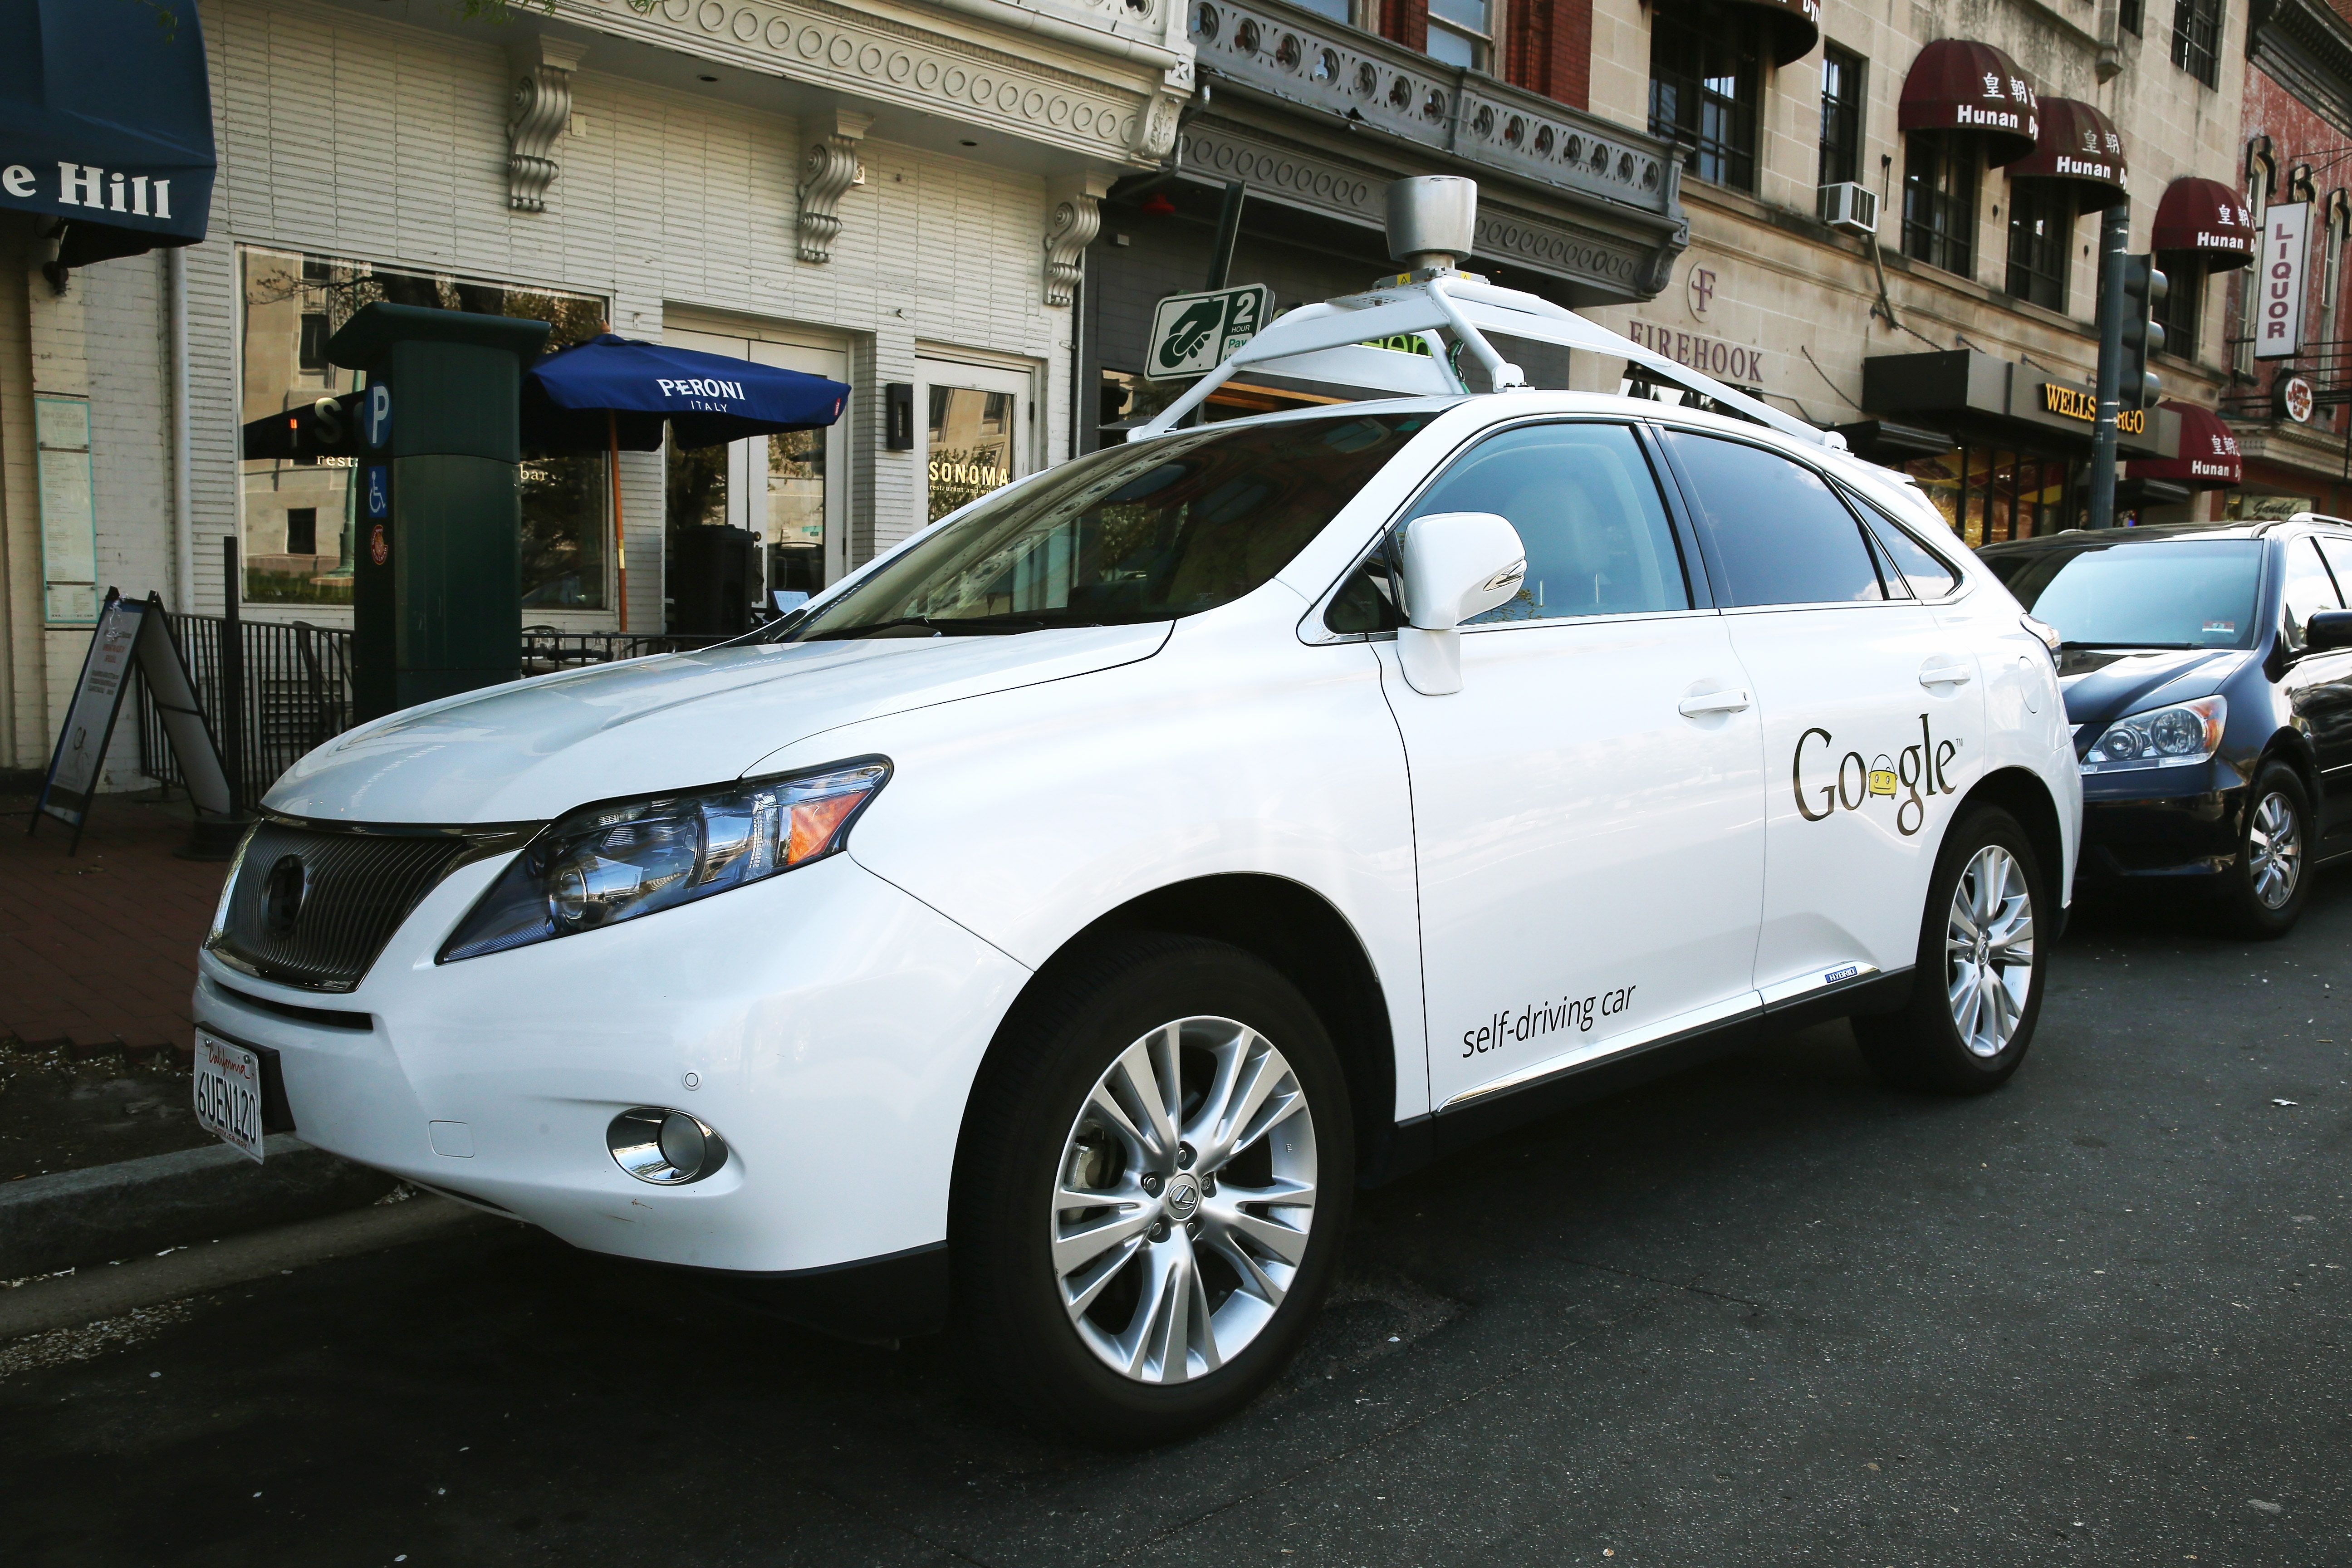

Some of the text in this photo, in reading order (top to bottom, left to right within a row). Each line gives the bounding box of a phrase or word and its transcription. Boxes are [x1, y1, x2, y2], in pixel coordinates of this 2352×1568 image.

[1957, 105, 2018, 128] Hunan
[2057, 156, 2111, 178] Hunan
[58, 162, 171, 219] Hill
[2218, 204, 2255, 230] 皇朝
[2197, 232, 2243, 249] Hunan
[2268, 223, 2293, 338] LIQUOR
[1233, 293, 1255, 324] 2
[1231, 325, 1250, 333] HOUR
[1629, 320, 1764, 382] FIREHOOK
[656, 378, 746, 400] PERONI
[372, 386, 390, 444] P
[691, 400, 729, 413] ITALY
[2045, 383, 2145, 434] WELLS RGO
[520, 464, 549, 480] bar
[929, 461, 1009, 487] SONOMA
[2192, 460, 2229, 476] Hunan
[1829, 968, 1856, 982] HYBRID
[1463, 985, 1636, 1058] self-driving car
[208, 1044, 250, 1080] California
[198, 1072, 256, 1145] 6UEN120
[214, 1125, 248, 1149] dmv.ca.gov
